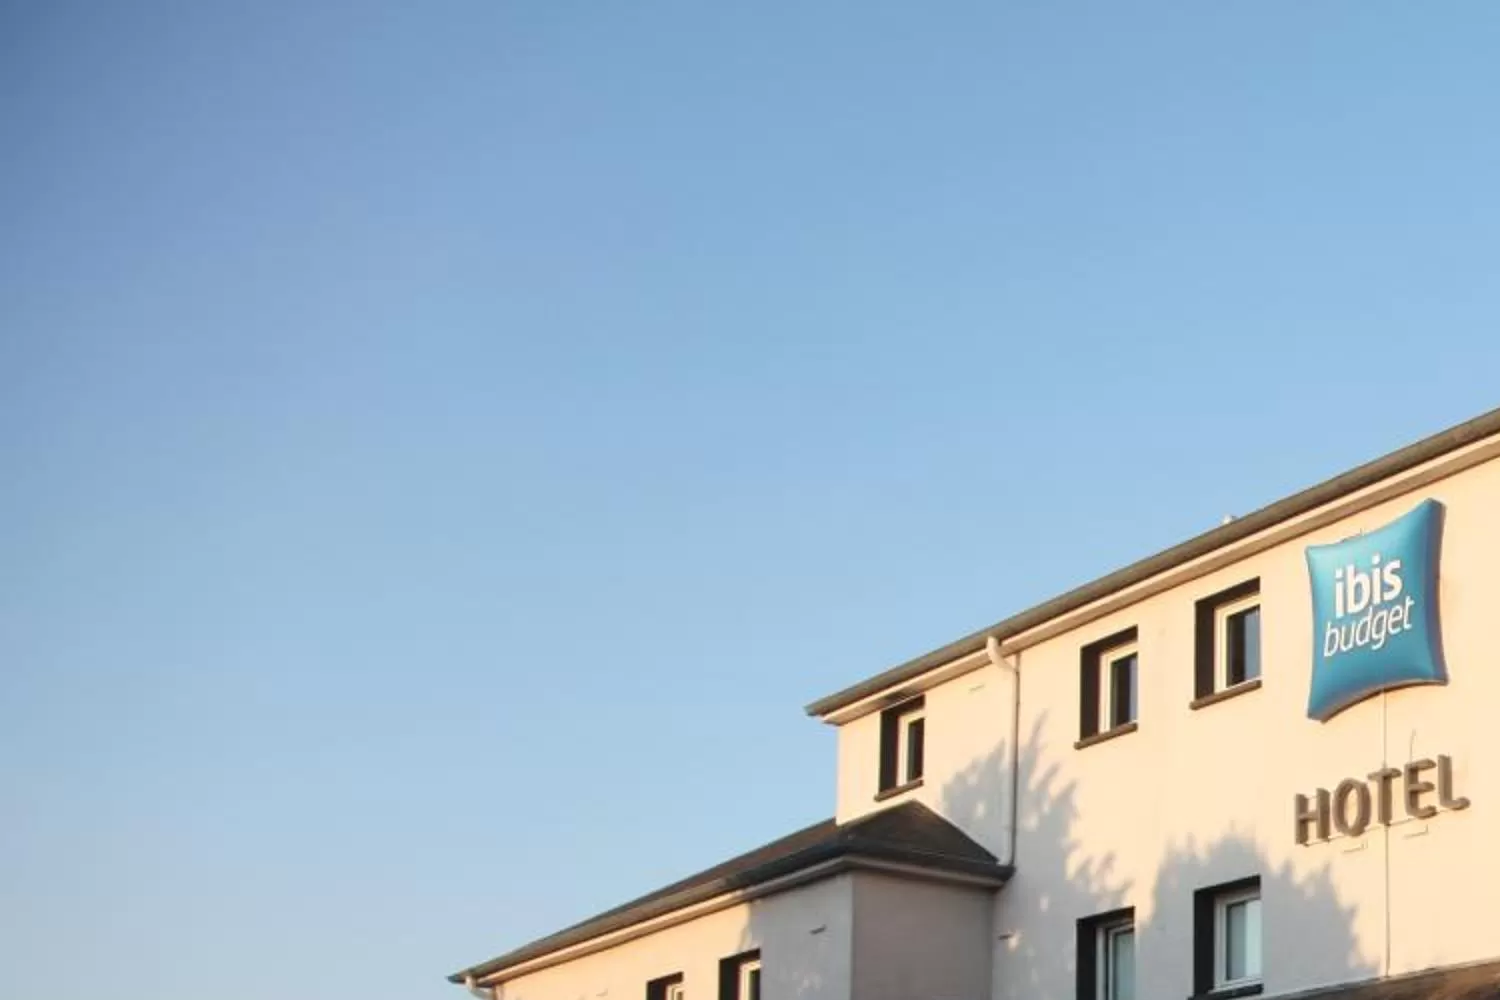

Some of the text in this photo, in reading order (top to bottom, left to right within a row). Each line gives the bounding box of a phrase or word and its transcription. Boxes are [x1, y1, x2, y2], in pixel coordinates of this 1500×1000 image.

[1334, 553, 1402, 617] ibis
[1323, 595, 1415, 657] budget
[1295, 755, 1470, 846] HOTEL
